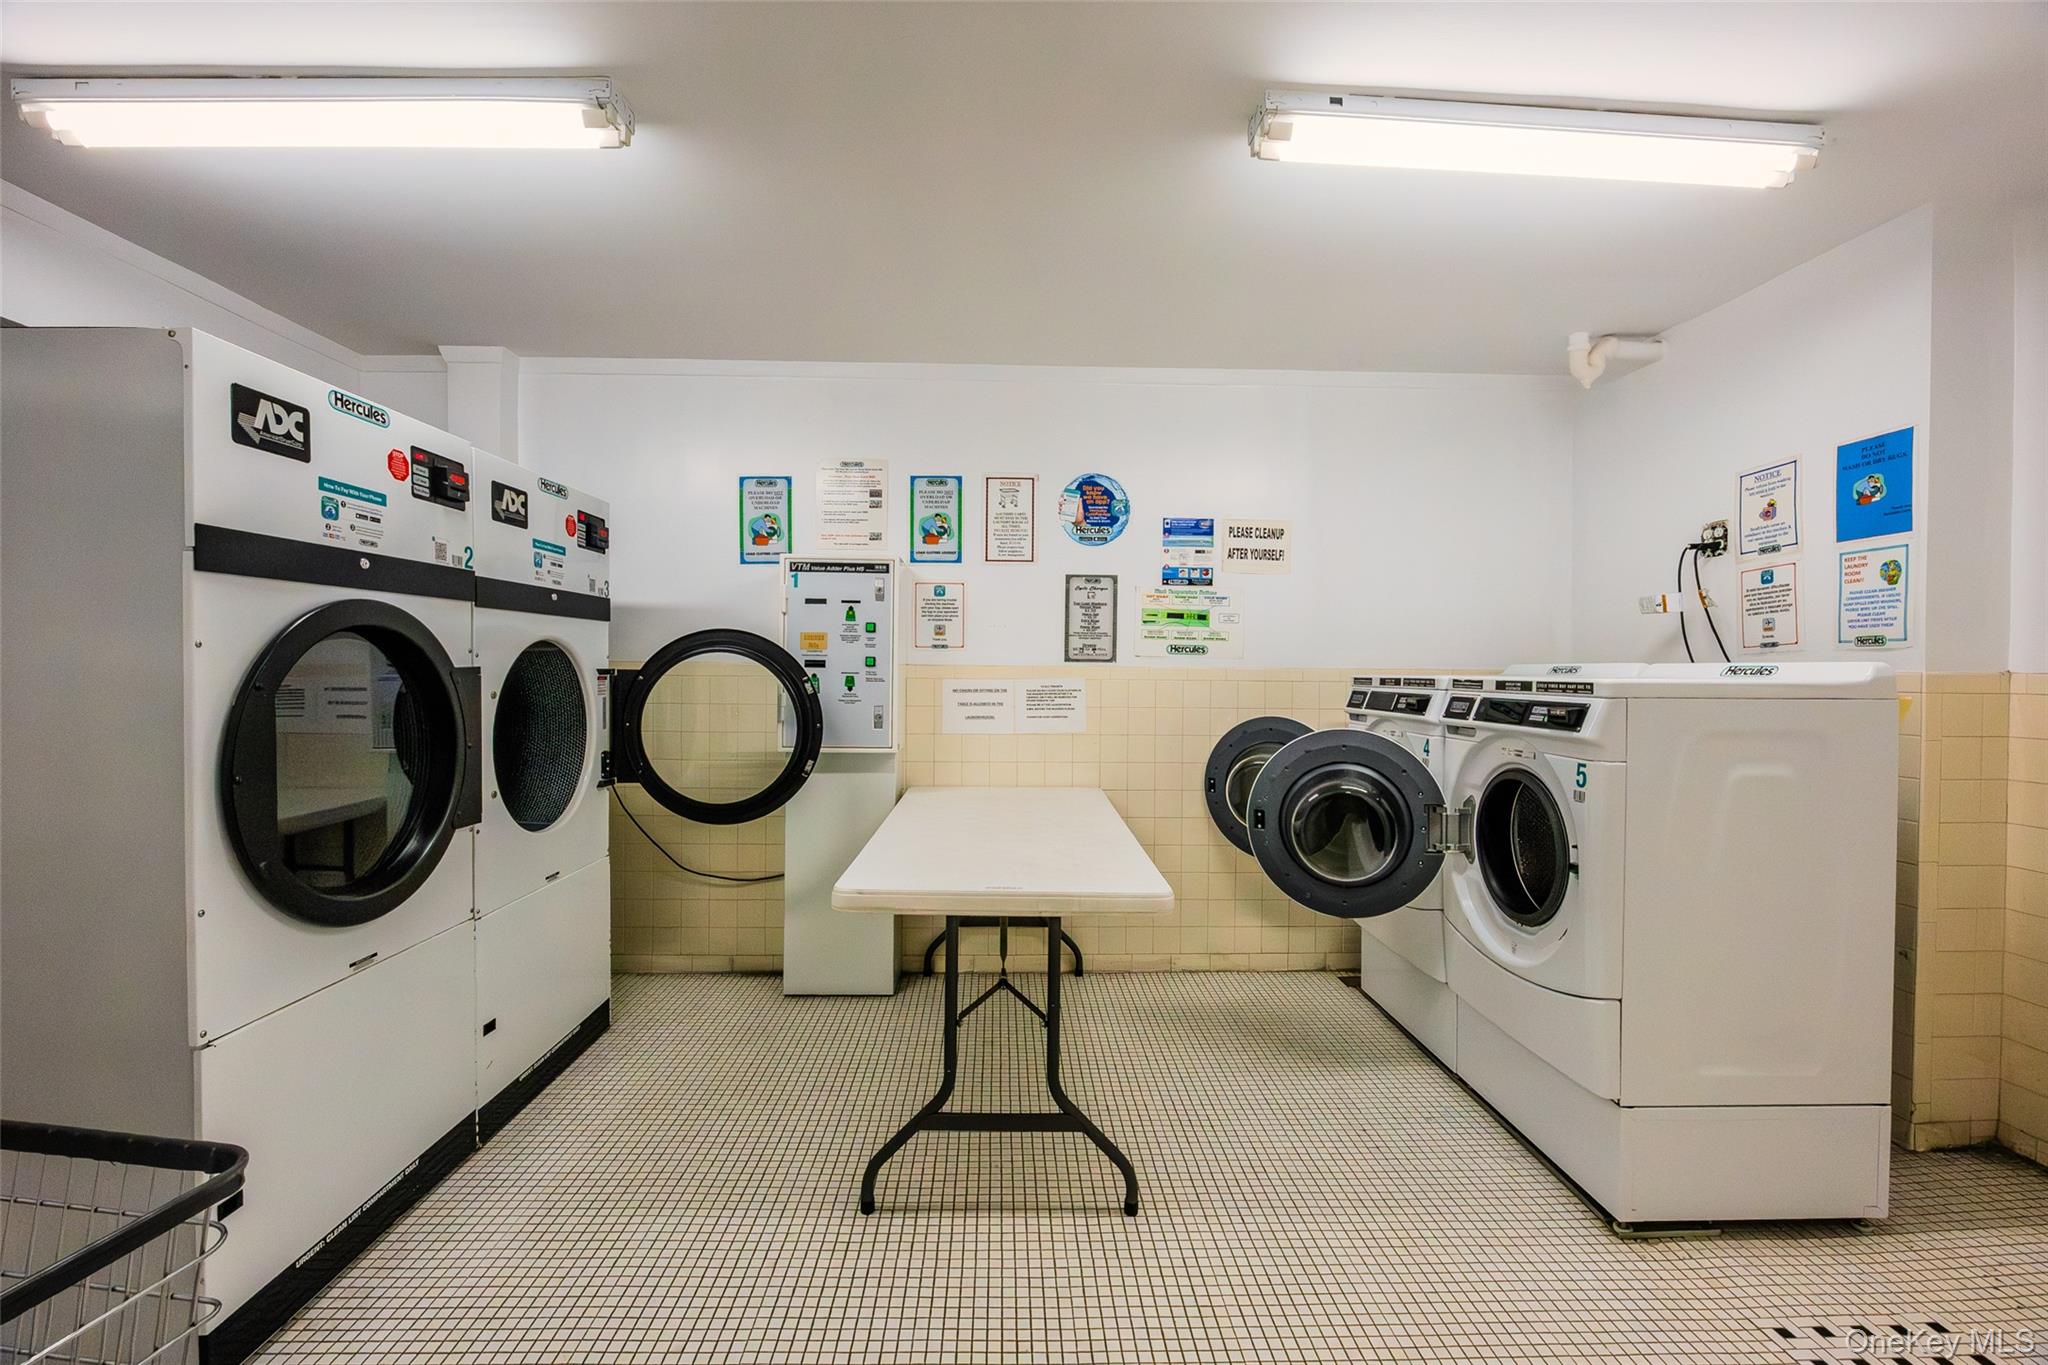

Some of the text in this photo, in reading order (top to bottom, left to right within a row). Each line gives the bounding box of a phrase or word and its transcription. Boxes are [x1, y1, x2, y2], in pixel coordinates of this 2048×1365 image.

[334, 392, 386, 424] Hercules
[254, 398, 304, 443] ADC
[1754, 470, 1782, 483] NOTICE
[340, 486, 348, 494] Pay
[540, 478, 567, 497] Hercules
[502, 488, 526, 515] ADC
[1076, 526, 1111, 534] Hercules
[1228, 526, 1285, 540] PLEASE CLEANUP
[464, 546, 474, 570] 2
[1227, 548, 1285, 562] AFTER YOURSELF!
[790, 562, 810, 571] VTM
[790, 572, 798, 588] 1
[604, 580, 610, 598] 3
[1857, 636, 1885, 645] Hercules
[1170, 644, 1206, 654] Hercules
[1550, 665, 1579, 674] Hercules
[1724, 666, 1775, 676] Hercules
[1424, 738, 1430, 757] 4
[1576, 762, 1587, 788] 5
[296, 1159, 420, 1269] URGENT: CLEAN LINT COMPARTMENT DAILY
